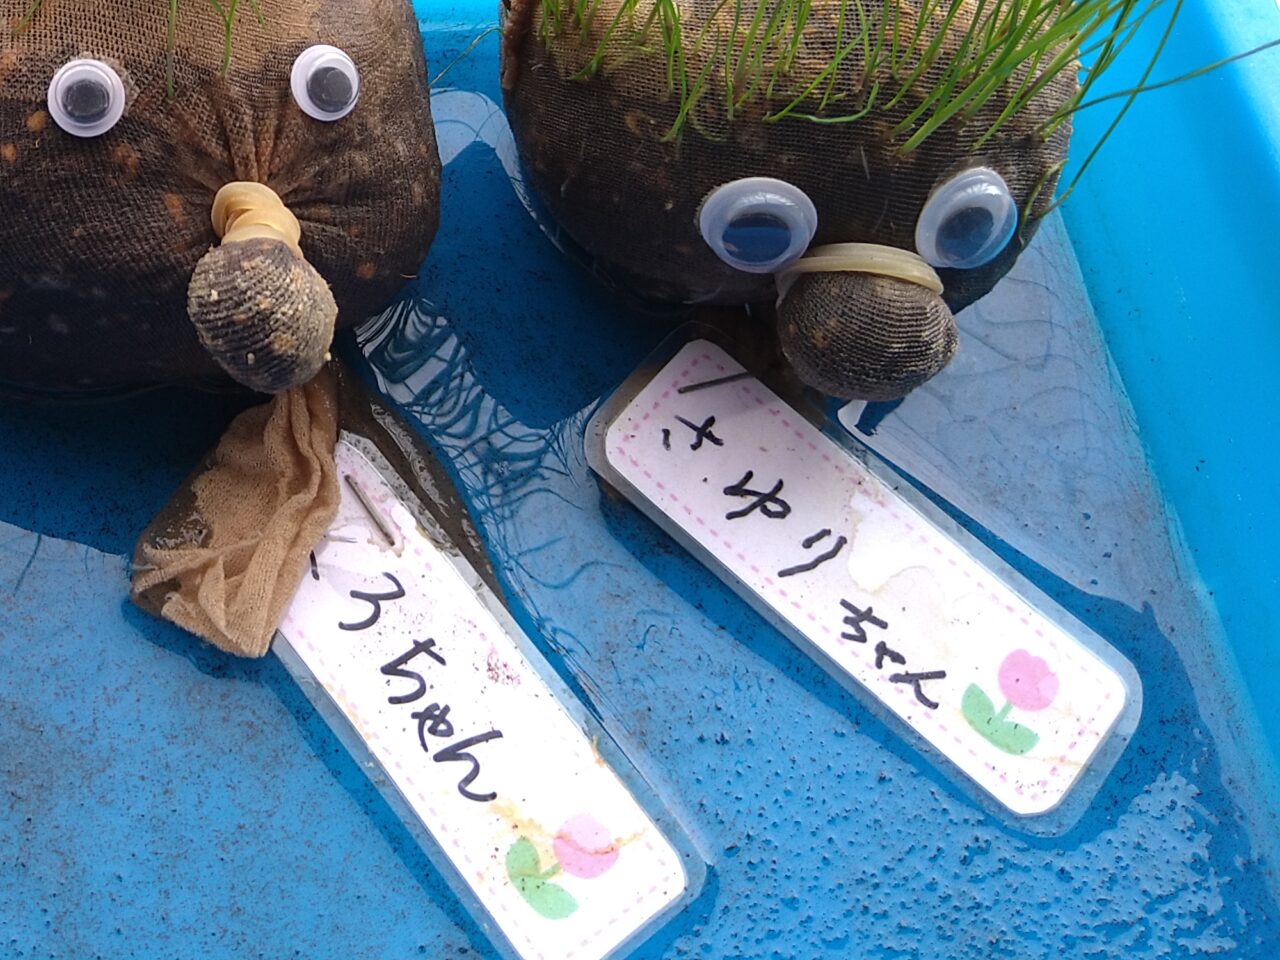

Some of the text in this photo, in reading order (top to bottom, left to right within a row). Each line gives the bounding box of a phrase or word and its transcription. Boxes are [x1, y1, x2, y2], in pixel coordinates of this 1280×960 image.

[661, 414, 947, 710] さゆりちゃん
